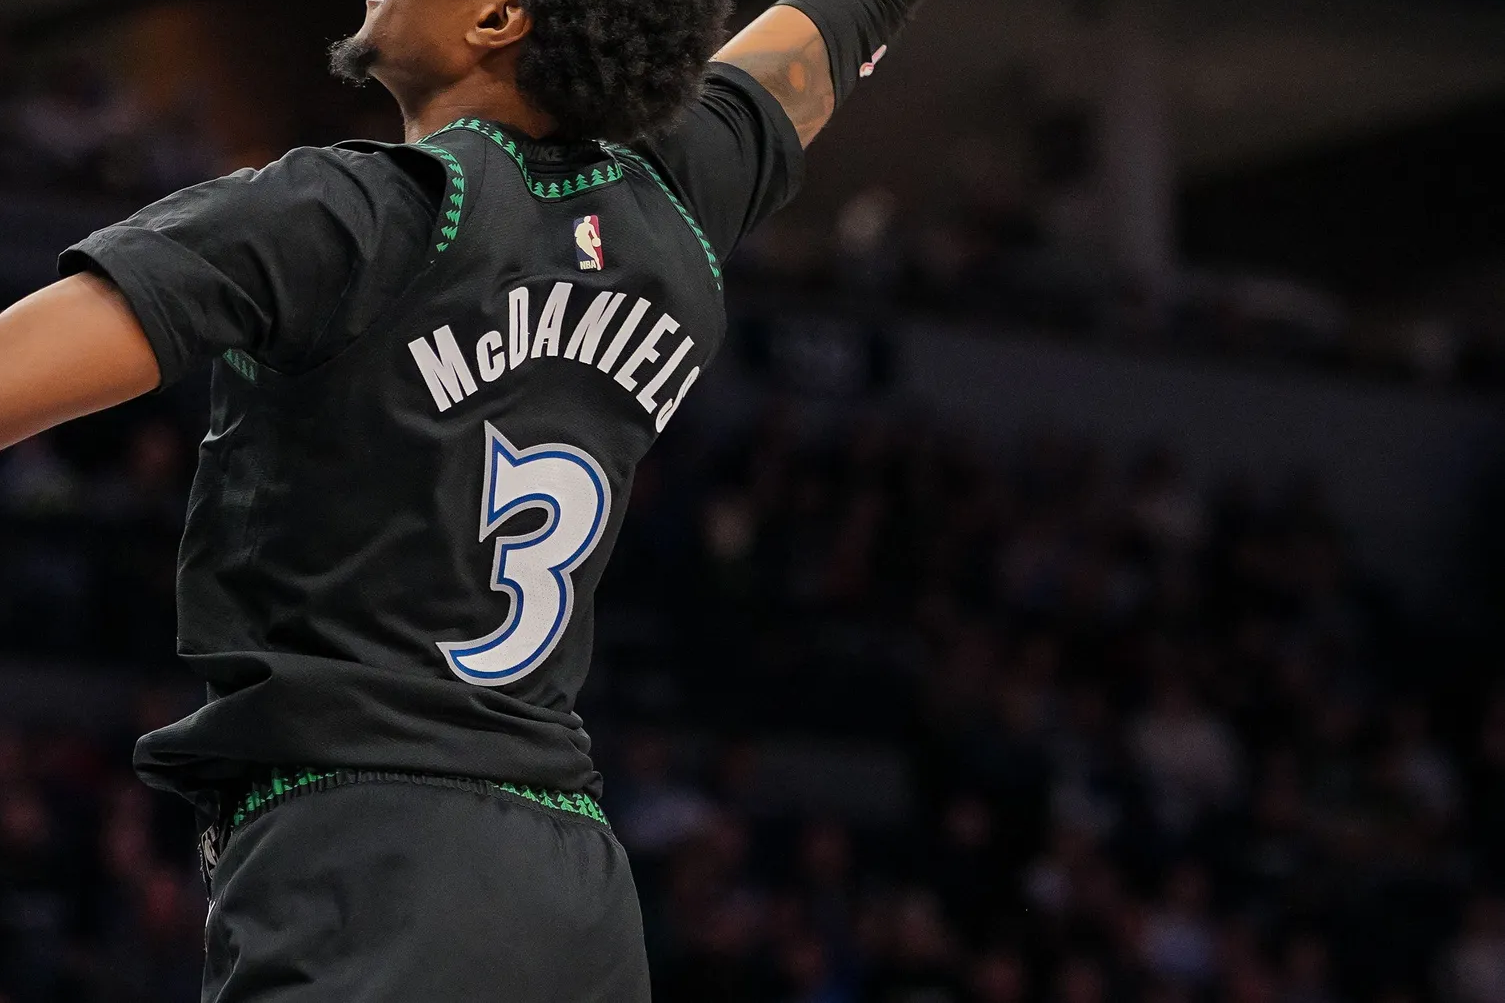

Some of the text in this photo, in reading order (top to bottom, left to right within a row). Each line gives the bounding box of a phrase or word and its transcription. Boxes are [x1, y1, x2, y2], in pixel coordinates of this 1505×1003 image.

[579, 259, 597, 271] NBA
[407, 282, 700, 434] McDANIELS
[435, 420, 612, 687] 3
